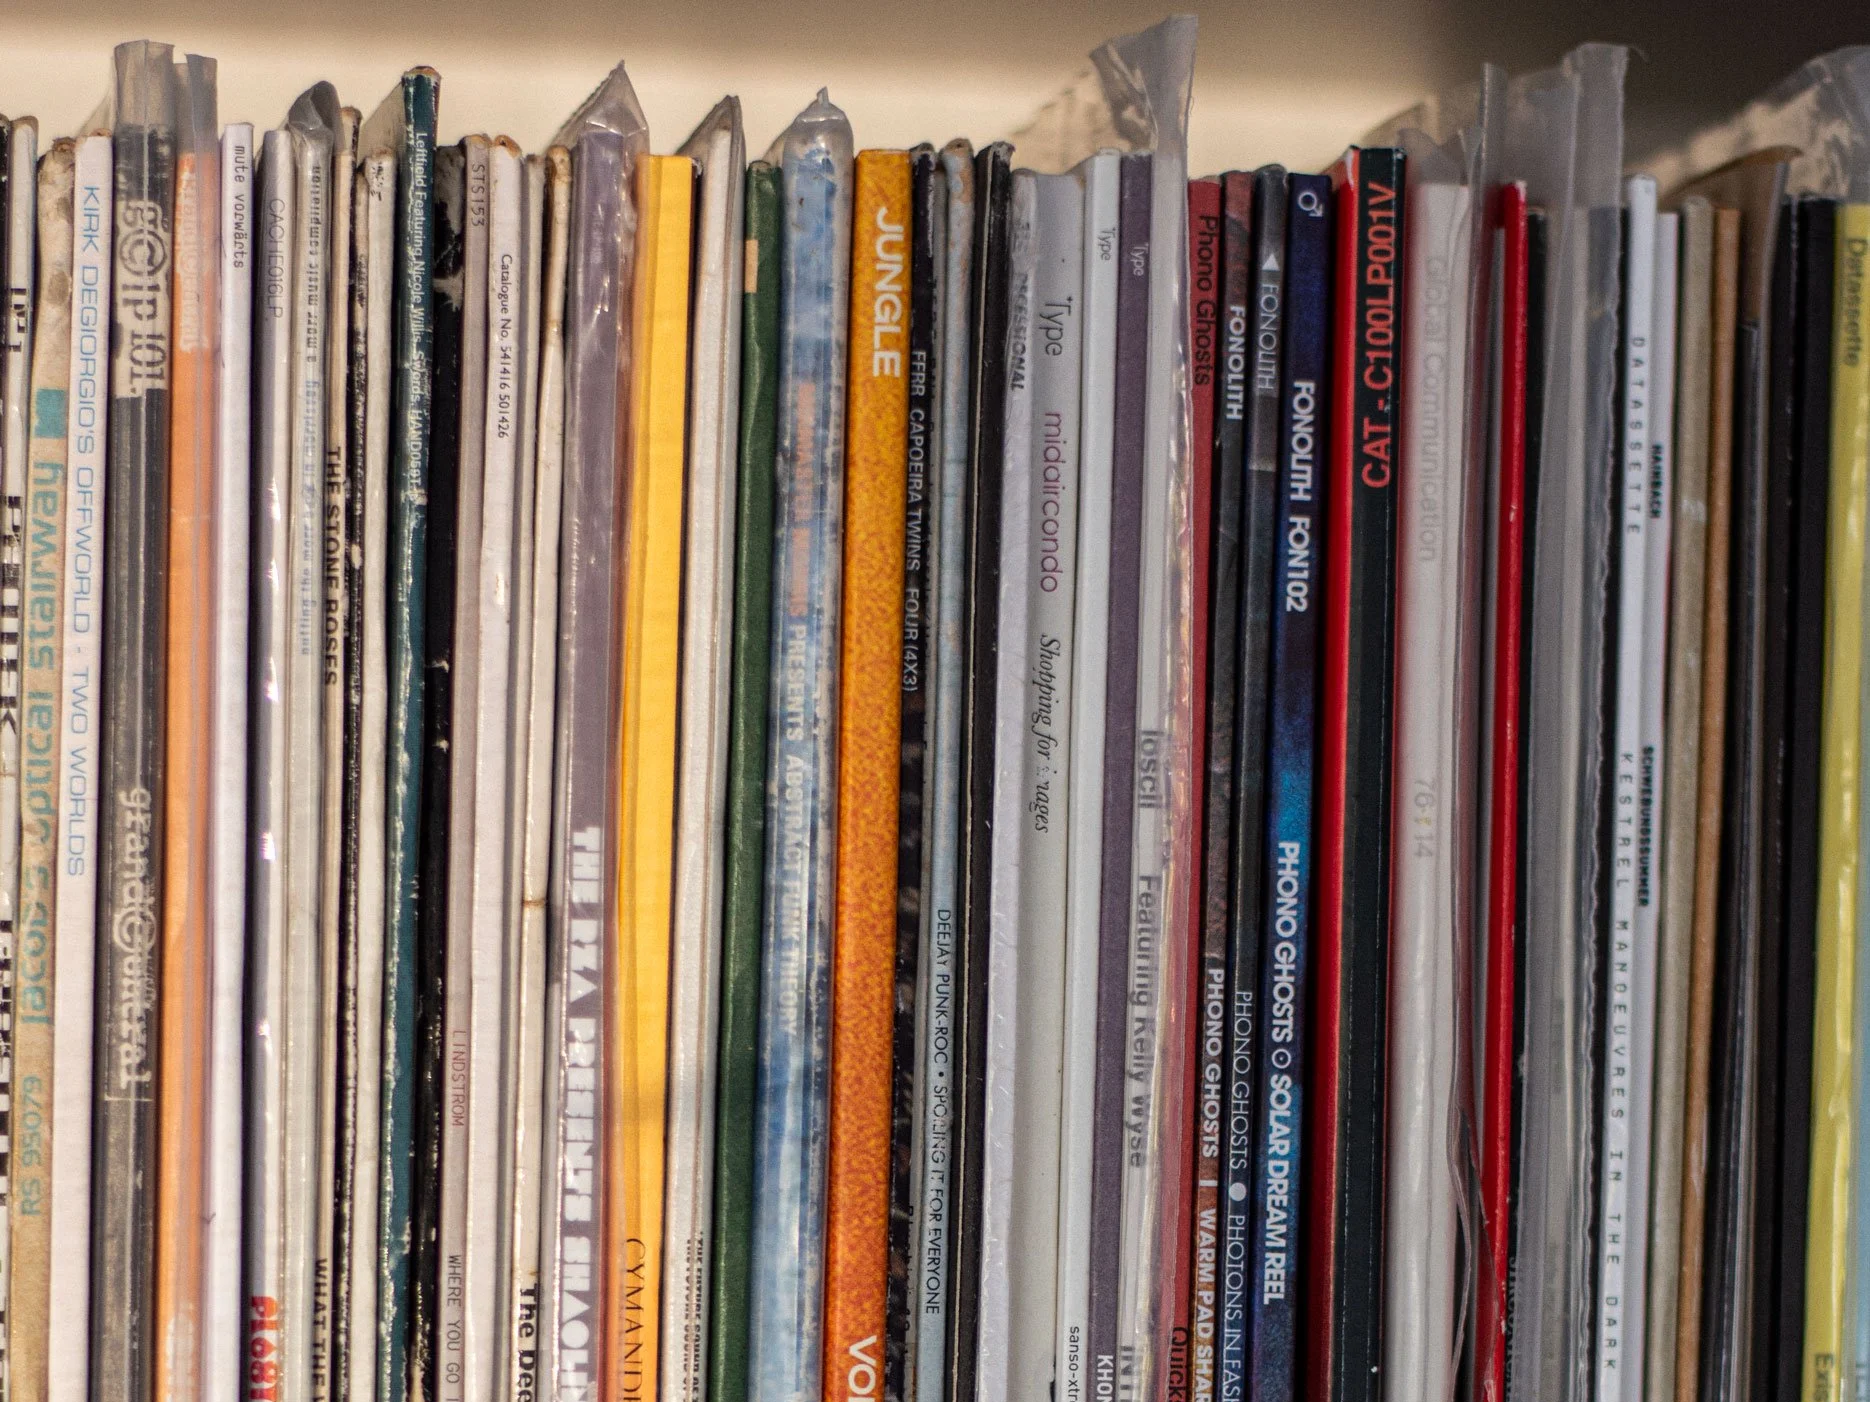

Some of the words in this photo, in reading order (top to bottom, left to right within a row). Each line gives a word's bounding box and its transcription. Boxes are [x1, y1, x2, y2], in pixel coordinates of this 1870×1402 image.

[234, 146, 247, 182] mute
[414, 132, 427, 187] Leftfield
[471, 164, 486, 228] STS153
[83, 187, 99, 252] KIRK
[234, 195, 248, 268] vorwärts
[412, 192, 425, 256] Featuring
[1197, 215, 1218, 290] Phono
[307, 263, 320, 306] music
[412, 261, 425, 303] Nicole
[497, 254, 513, 314] Catalogue
[873, 207, 904, 377] JUNGLE
[1364, 182, 1395, 390] C100LP001V
[1423, 256, 1447, 341] Global
[1844, 238, 1868, 367] Datassette
[77, 265, 98, 454] DEGIORGIO'S
[307, 312, 317, 348] morr
[499, 319, 511, 341] No.
[499, 346, 511, 389] 541416
[1195, 300, 1216, 386] Ghosts
[1226, 305, 1245, 421] FONOLITH
[1257, 283, 1278, 389] FONOLITH
[911, 351, 926, 396] FFRR
[498, 394, 510, 438] 501426
[1290, 381, 1314, 500] FONOLITH
[1363, 417, 1391, 487] CAT
[1627, 337, 1645, 534] DATASSETTE
[326, 447, 341, 497] THE
[908, 408, 925, 503] CAPOEIRA
[1418, 355, 1444, 561] Communication
[1650, 444, 1662, 519] HAINBACH
[906, 508, 921, 570] TWINS
[1039, 412, 1066, 592] midaircondo
[29, 461, 67, 671] stairway
[73, 467, 93, 633] OFFWORLD
[325, 505, 341, 590] STONE
[1287, 516, 1309, 612] FON102
[324, 600, 339, 687] ROSES
[905, 588, 920, 640] FOUR
[70, 667, 88, 733] TWO
[786, 624, 807, 741] PRESENTS
[902, 645, 919, 691] (4X3)
[1032, 634, 1061, 726] Shopping
[26, 690, 57, 847] optical
[1032, 724, 1058, 760] for
[1138, 730, 1166, 809] loscil
[68, 749, 87, 877] WORLDS
[783, 755, 804, 874] ABSTRACT
[1617, 754, 1633, 888] KESTREL
[571, 827, 601, 905] THE
[1275, 841, 1299, 938] PHONO
[782, 880, 801, 940] FUNK
[936, 910, 951, 968] DEEJAY
[1130, 875, 1161, 1006] Featuring
[569, 920, 599, 1004] RZA
[780, 948, 799, 1035] THEORY
[1272, 942, 1296, 1042] GHOSTS
[934, 975, 950, 1064] PUNK-ROC
[1127, 1016, 1156, 1082] Kelly
[1205, 969, 1222, 1056] PHONO
[1234, 991, 1252, 1074] PHONO
[1611, 920, 1629, 1118] MANOEUVRES
[452, 1030, 466, 1127] LINDSTROM
[1202, 1063, 1220, 1157] GHOSTS
[1268, 1074, 1291, 1154] SOLAR
[22, 1075, 42, 1167] 95079
[565, 1018, 597, 1222] PRESENTS
[932, 1086, 948, 1164] SPOILING
[1126, 1095, 1153, 1168] Wyse
[1230, 1081, 1250, 1170] GHOSTS
[22, 1176, 42, 1216] RS
[929, 1188, 943, 1222] FOR
[931, 1170, 945, 1180] IT
[1266, 1160, 1289, 1246] DREAM
[1609, 1151, 1623, 1181] IN
[926, 1228, 942, 1315] EVERYONE
[1198, 1208, 1216, 1282] WARM
[1226, 1214, 1244, 1320] PHOTONS
[1607, 1213, 1621, 1264] THE
[313, 1258, 327, 1329] WHAT
[448, 1254, 461, 1307] WHERE
[519, 1283, 537, 1338] The
[1197, 1290, 1214, 1337] PAD
[1263, 1252, 1286, 1304] REEL
[312, 1339, 326, 1386] THE
[447, 1320, 460, 1351] YOU
[1225, 1328, 1241, 1351] IN
[1605, 1296, 1618, 1369] DARK
[446, 1363, 460, 1384] GO
